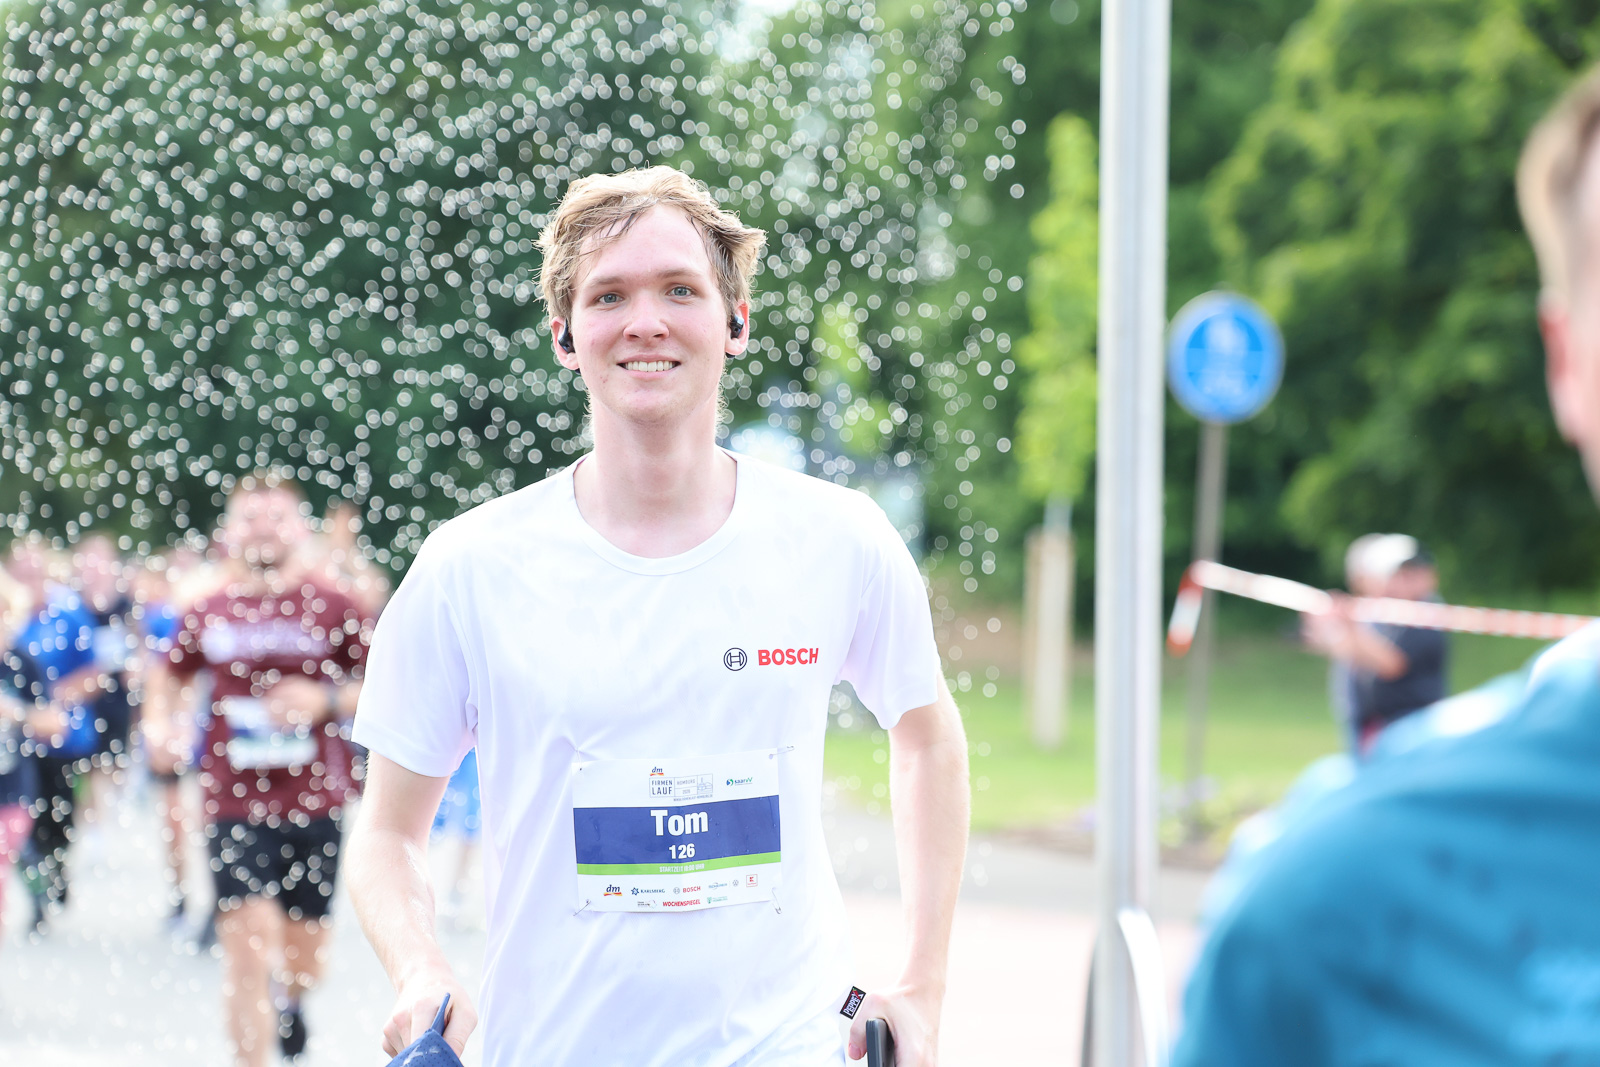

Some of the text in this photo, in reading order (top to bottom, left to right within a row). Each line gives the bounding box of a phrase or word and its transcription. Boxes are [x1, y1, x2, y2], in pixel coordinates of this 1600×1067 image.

[757, 647, 819, 666] BOSCH
[651, 766, 663, 774] dm
[651, 786, 673, 795] LAUF
[650, 809, 709, 836] Tom
[668, 843, 696, 860] 126
[605, 884, 621, 893] dm
[662, 899, 701, 907] WOCHENSPIEGEL
